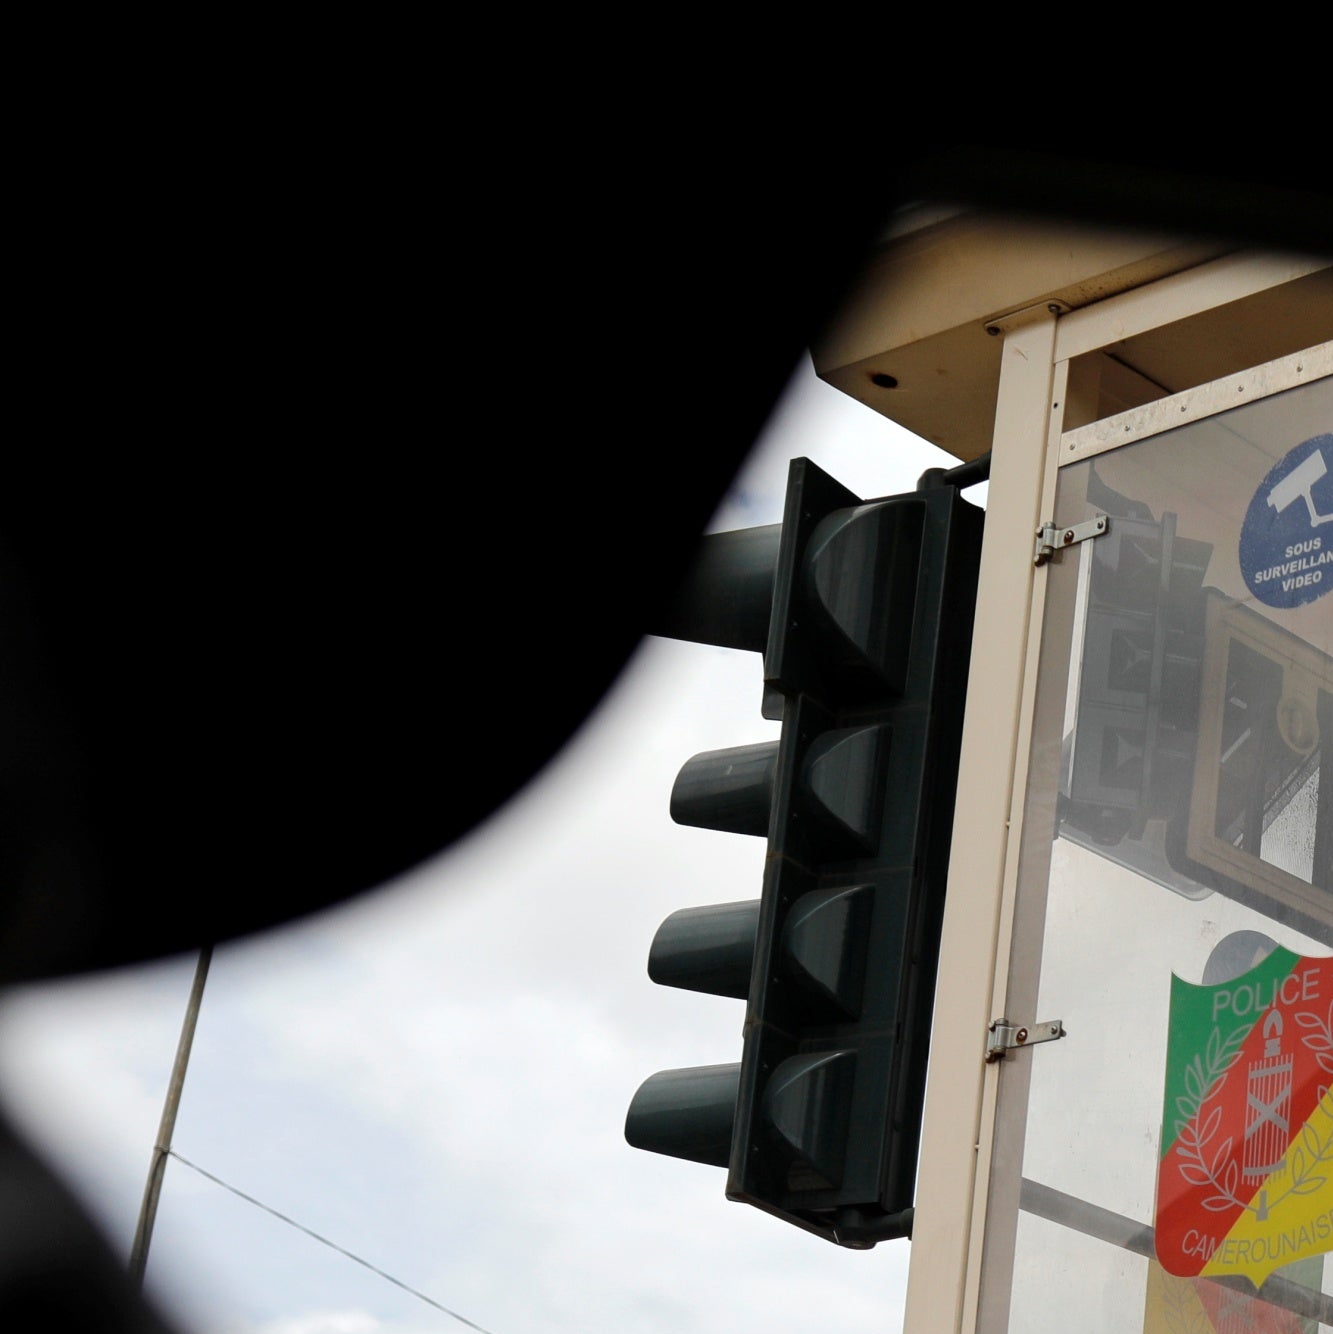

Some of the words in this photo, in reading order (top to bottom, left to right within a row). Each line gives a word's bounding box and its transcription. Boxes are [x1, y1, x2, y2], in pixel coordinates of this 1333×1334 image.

[1285, 538, 1321, 558] SOUS
[1282, 570, 1322, 592] VIDEO
[1212, 968, 1320, 1022] POLICE
